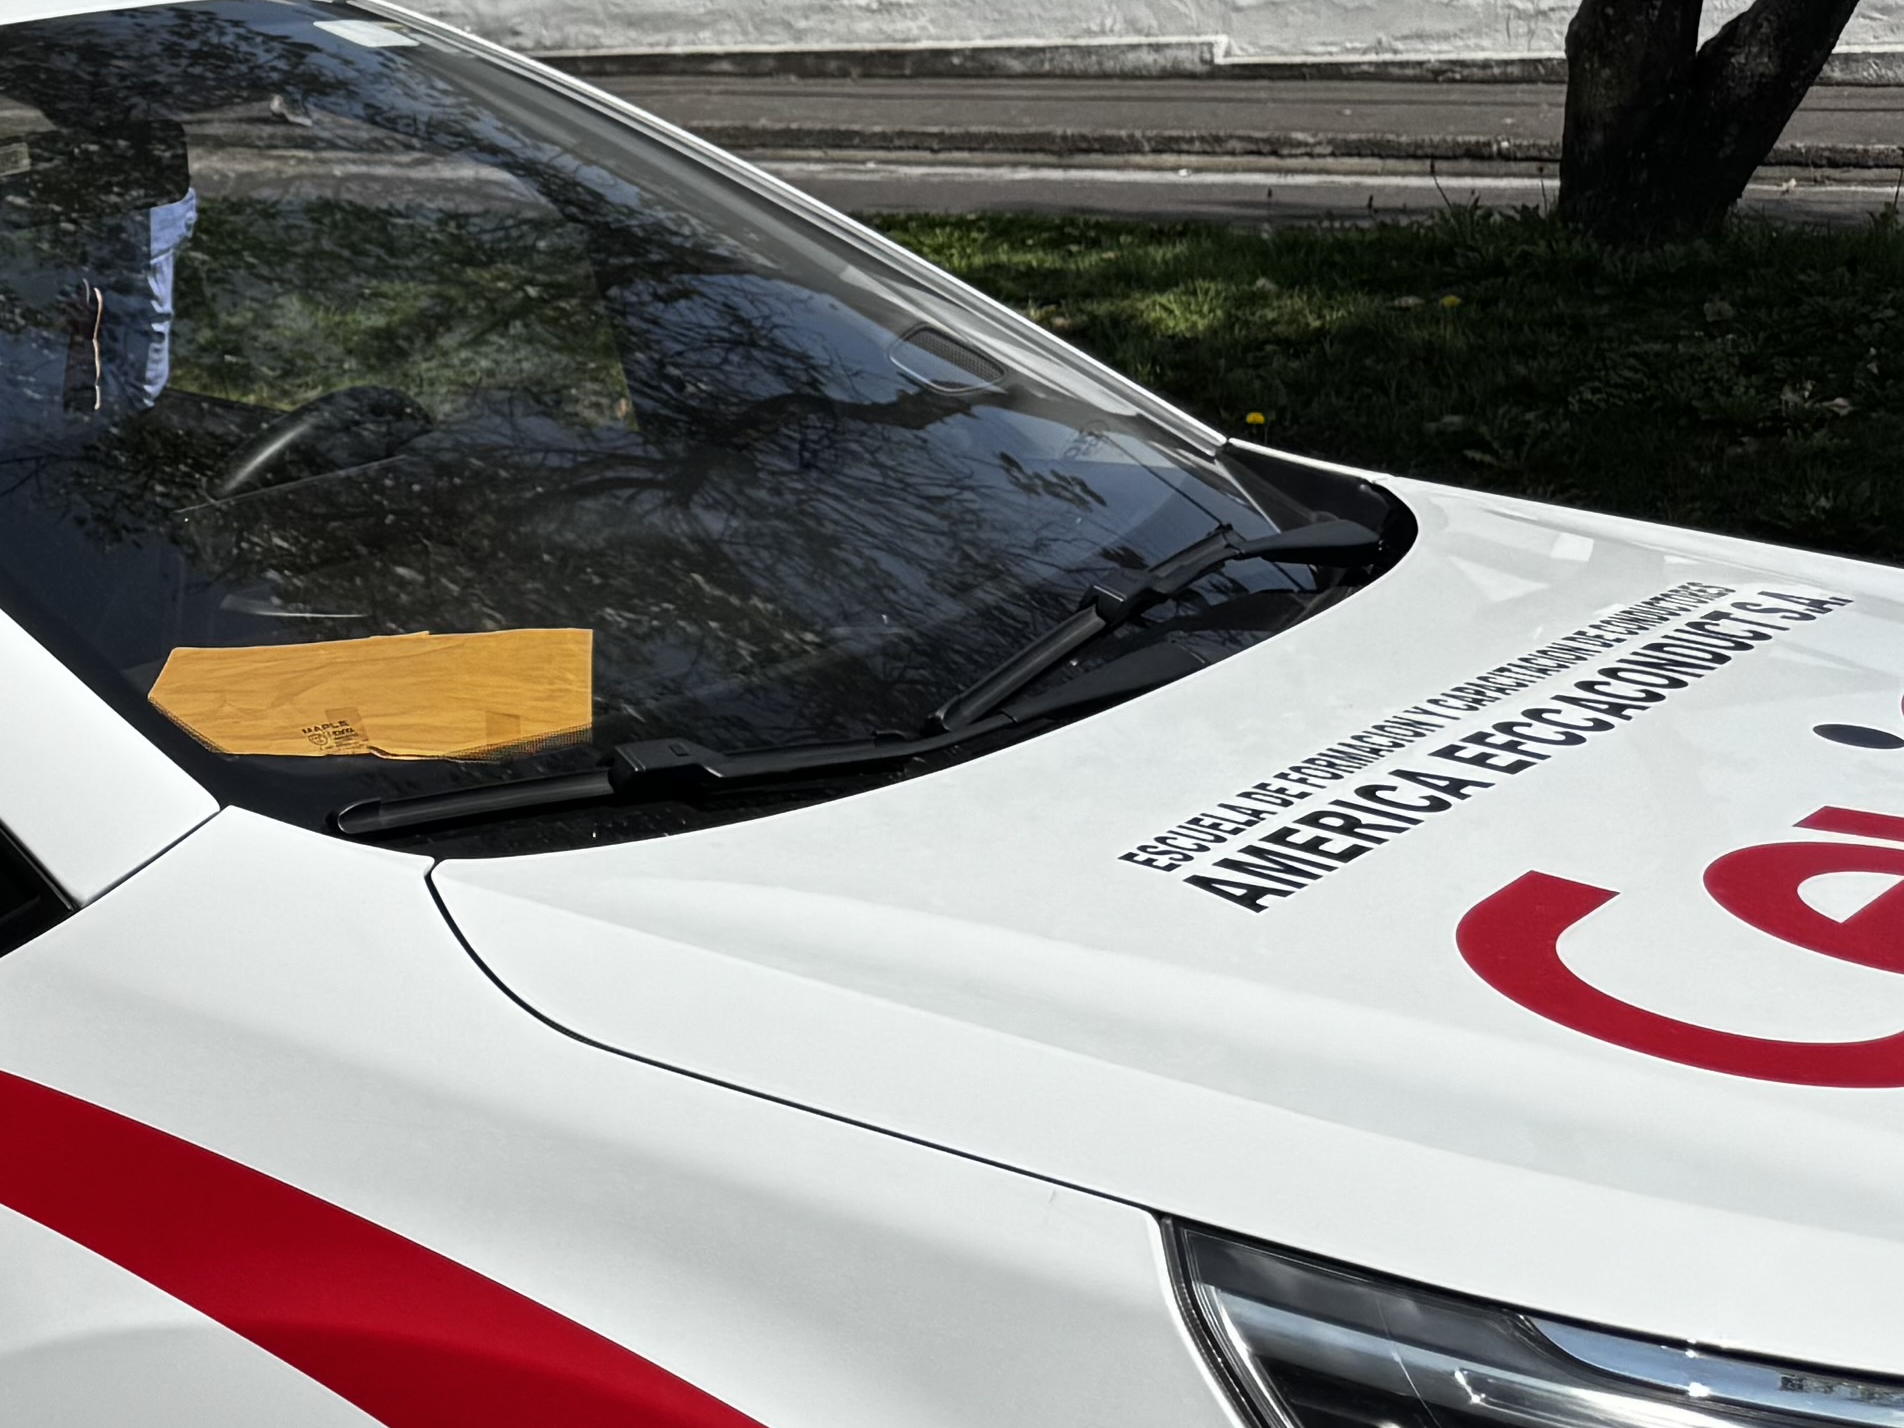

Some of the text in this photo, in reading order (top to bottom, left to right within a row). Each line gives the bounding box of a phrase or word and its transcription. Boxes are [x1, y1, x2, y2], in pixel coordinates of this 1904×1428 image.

[1117, 582, 1736, 872] ESCUELA DE FORMACION Y CAPACITACION DE CONDUCTORES
[1182, 590, 1854, 913] AMERICA EFCCACONDUCT S.A.
[1456, 806, 1904, 1089] Ce
